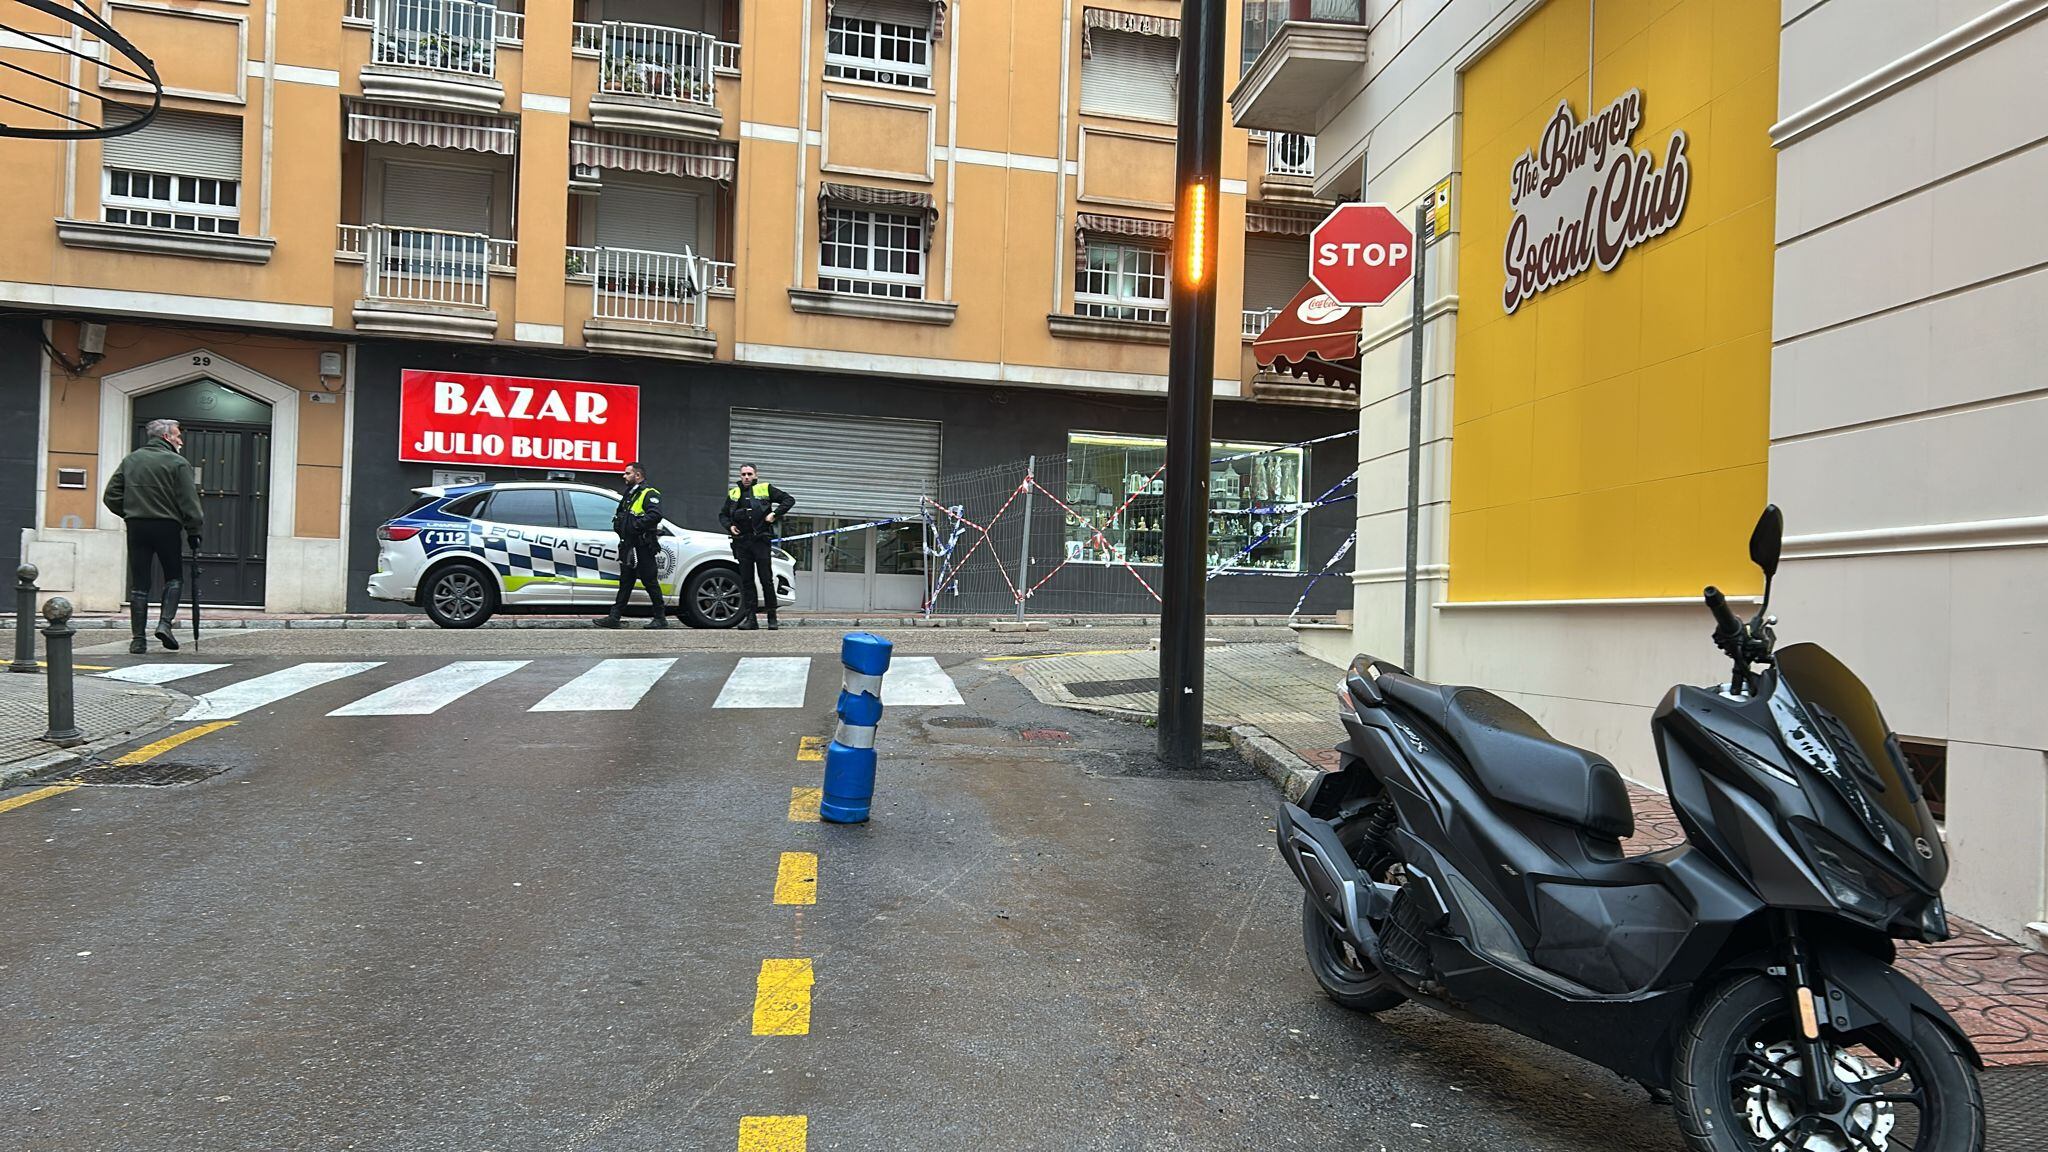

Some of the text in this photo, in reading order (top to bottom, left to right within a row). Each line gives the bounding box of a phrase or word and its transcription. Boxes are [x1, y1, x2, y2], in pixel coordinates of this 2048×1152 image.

[1512, 94, 1637, 205] The Burger
[1504, 185, 1598, 308] Social
[1597, 135, 1684, 265] Club
[1318, 242, 1408, 267] STOP
[192, 356, 211, 366] 29
[434, 381, 608, 425] BAZAR
[414, 431, 624, 464] JULIO BURELL
[435, 531, 466, 545] 112
[574, 542, 622, 563] LOC
